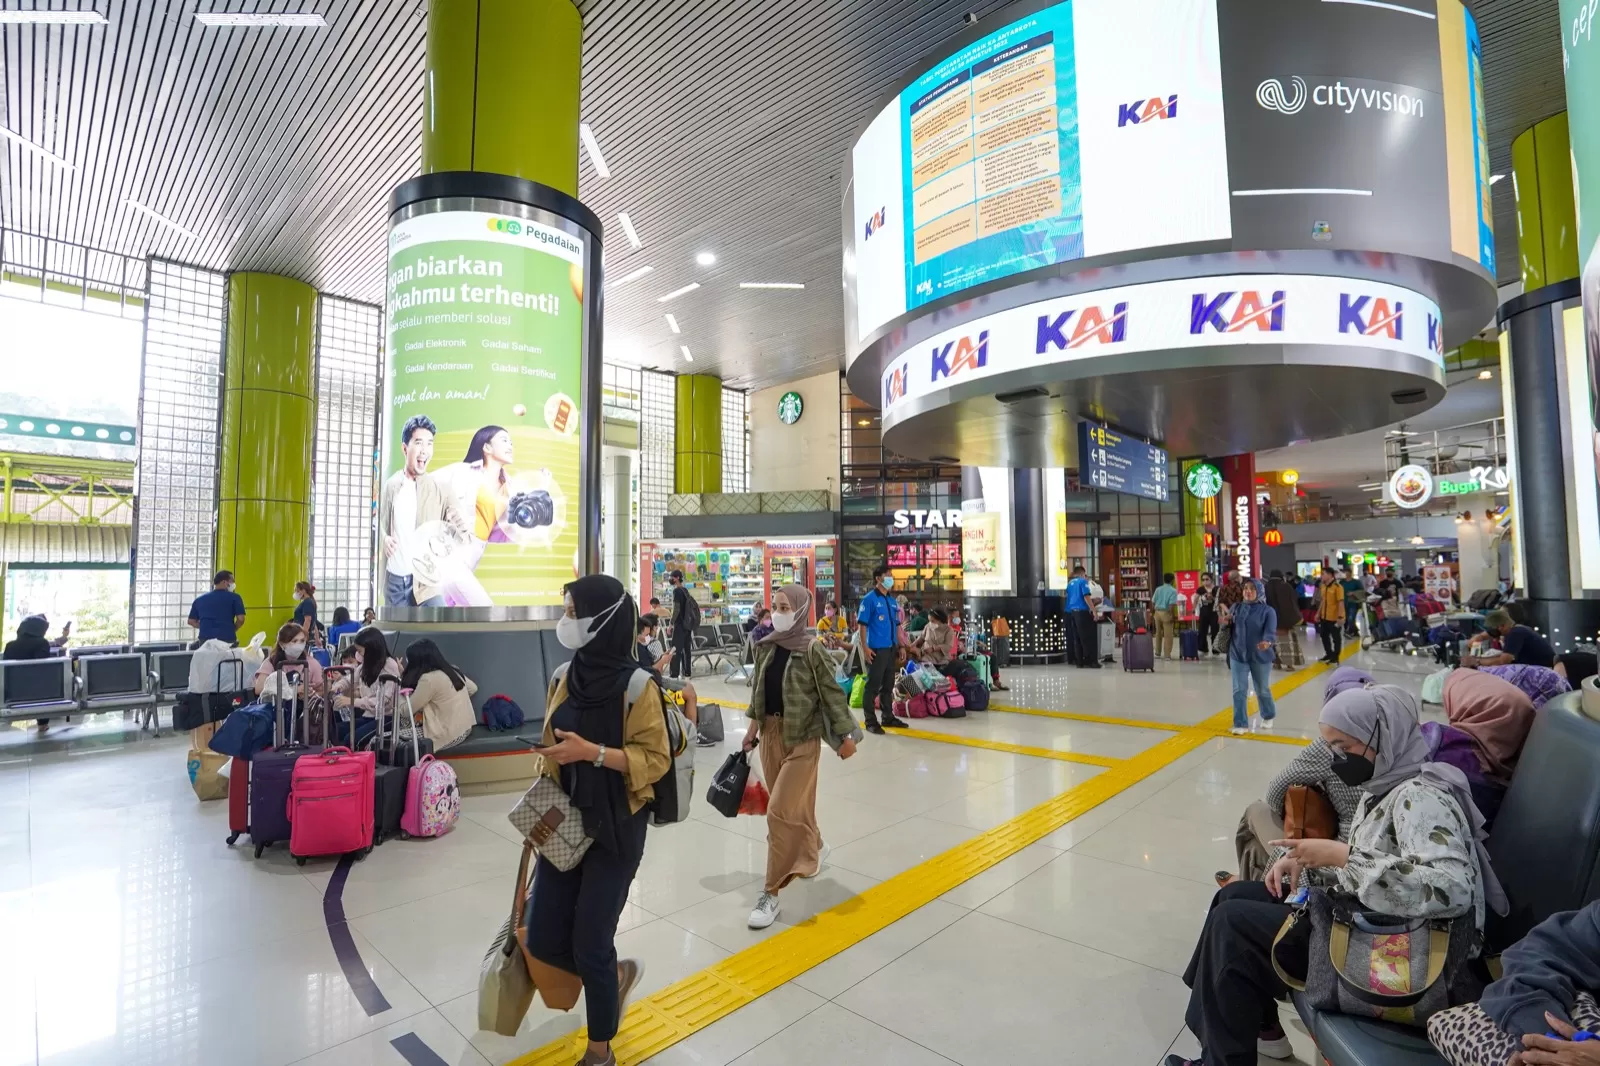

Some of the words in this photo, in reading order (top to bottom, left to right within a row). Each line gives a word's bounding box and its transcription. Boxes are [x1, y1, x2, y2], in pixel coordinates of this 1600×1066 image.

[966, 47, 992, 64] AGUSTUS
[993, 39, 1008, 50] 2022
[972, 42, 986, 54] NAIK
[998, 20, 1037, 40] ANTARKOTA
[993, 44, 1027, 63] KETERANGAN
[918, 93, 932, 106] STATUS
[933, 77, 958, 96] PENUMPANG
[1312, 82, 1424, 118] cityvision
[1118, 94, 1178, 127] KAI
[865, 206, 885, 241] KAI
[526, 225, 580, 255] Pegadaian
[417, 255, 503, 278] biarkan
[461, 282, 560, 316] terhenti!
[916, 279, 931, 294] KAI
[399, 316, 422, 329] selalu
[425, 312, 473, 324] memberi
[477, 314, 511, 326] solusi
[1190, 290, 1286, 334] KAI
[1338, 293, 1403, 340] KAI
[1036, 301, 1129, 354] KAI
[405, 341, 424, 351] Gadai
[426, 339, 466, 348] Elektronik
[482, 339, 510, 349] Gadai
[512, 342, 542, 354] Saham
[931, 329, 990, 382] KAI
[406, 364, 426, 374] Gadai
[427, 362, 473, 372] Kendaraan
[491, 362, 519, 373] Gadai
[521, 365, 556, 380] Sertifikat
[419, 386, 440, 399] dan
[446, 384, 490, 400] aman!
[886, 362, 908, 408] KAI
[1440, 481, 1480, 494] Bugis
[893, 509, 962, 528] STAR
[1236, 495, 1251, 578] McDonald's
